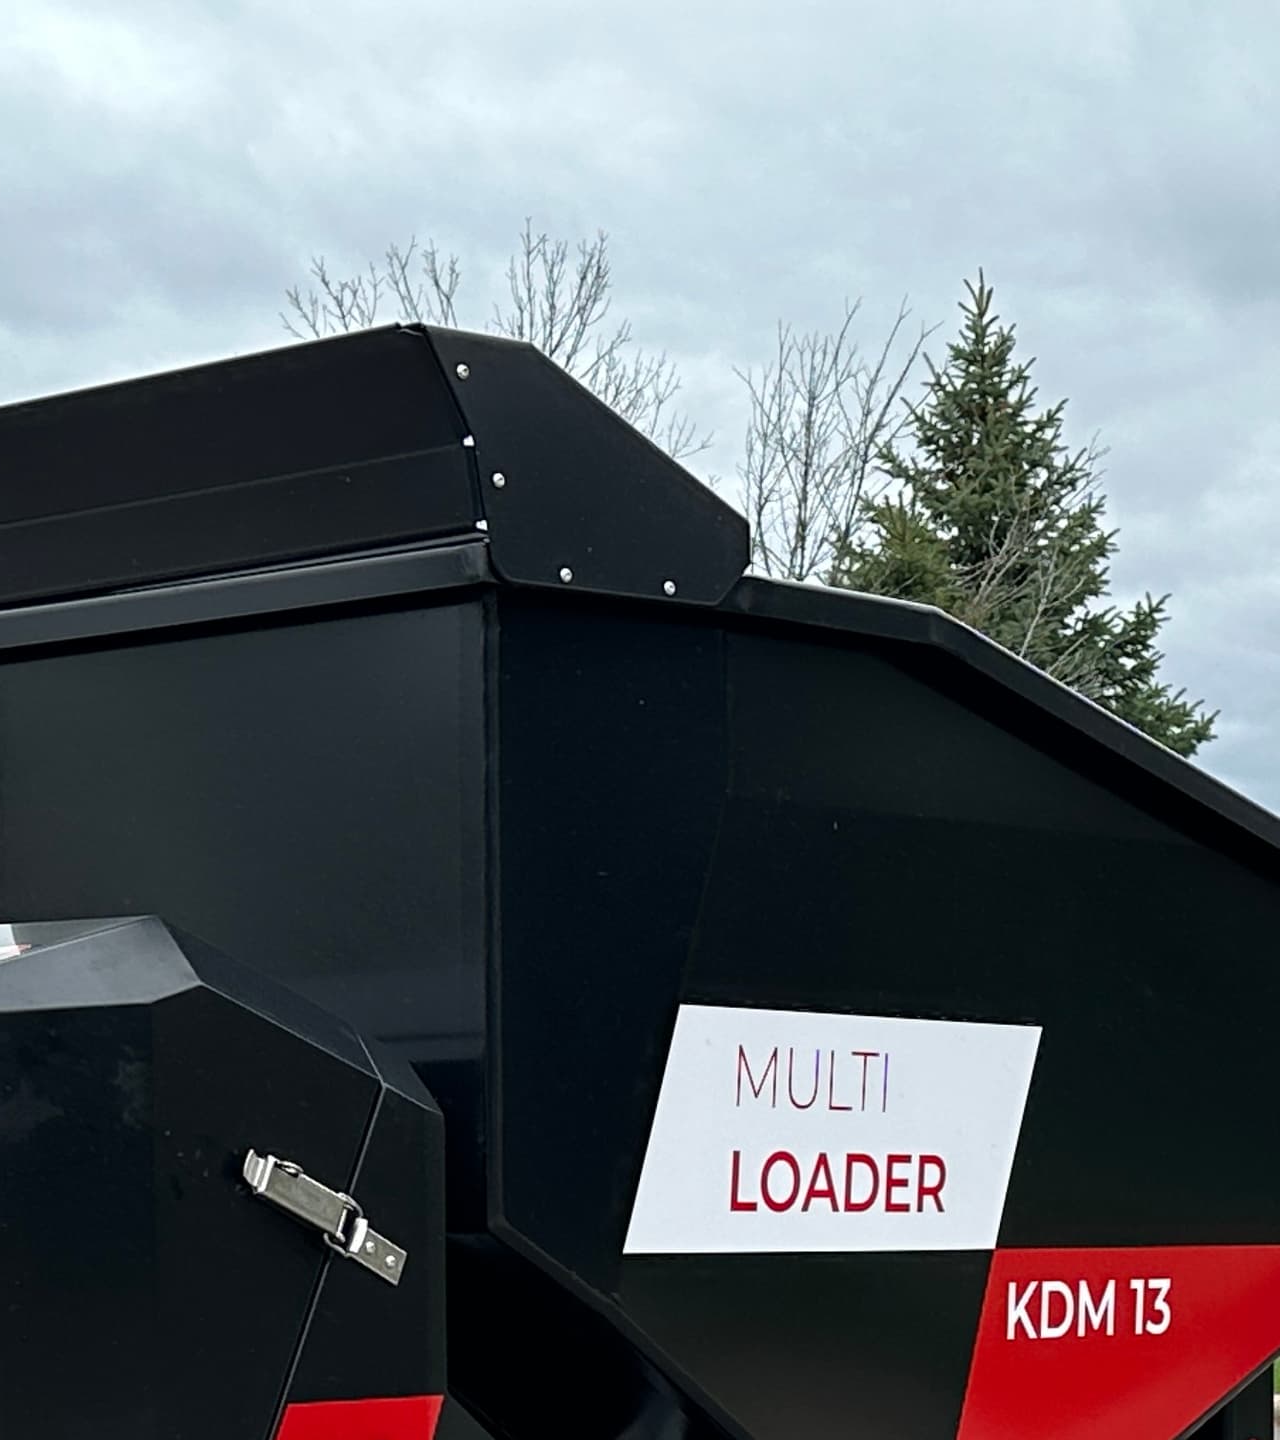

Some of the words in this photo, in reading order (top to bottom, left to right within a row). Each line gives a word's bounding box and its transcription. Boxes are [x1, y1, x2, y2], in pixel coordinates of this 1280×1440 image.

[735, 1043, 889, 1113] MULTI
[730, 1150, 948, 1214] LOADER
[1006, 1280, 1115, 1341] KDM
[1130, 1277, 1172, 1336] 13
